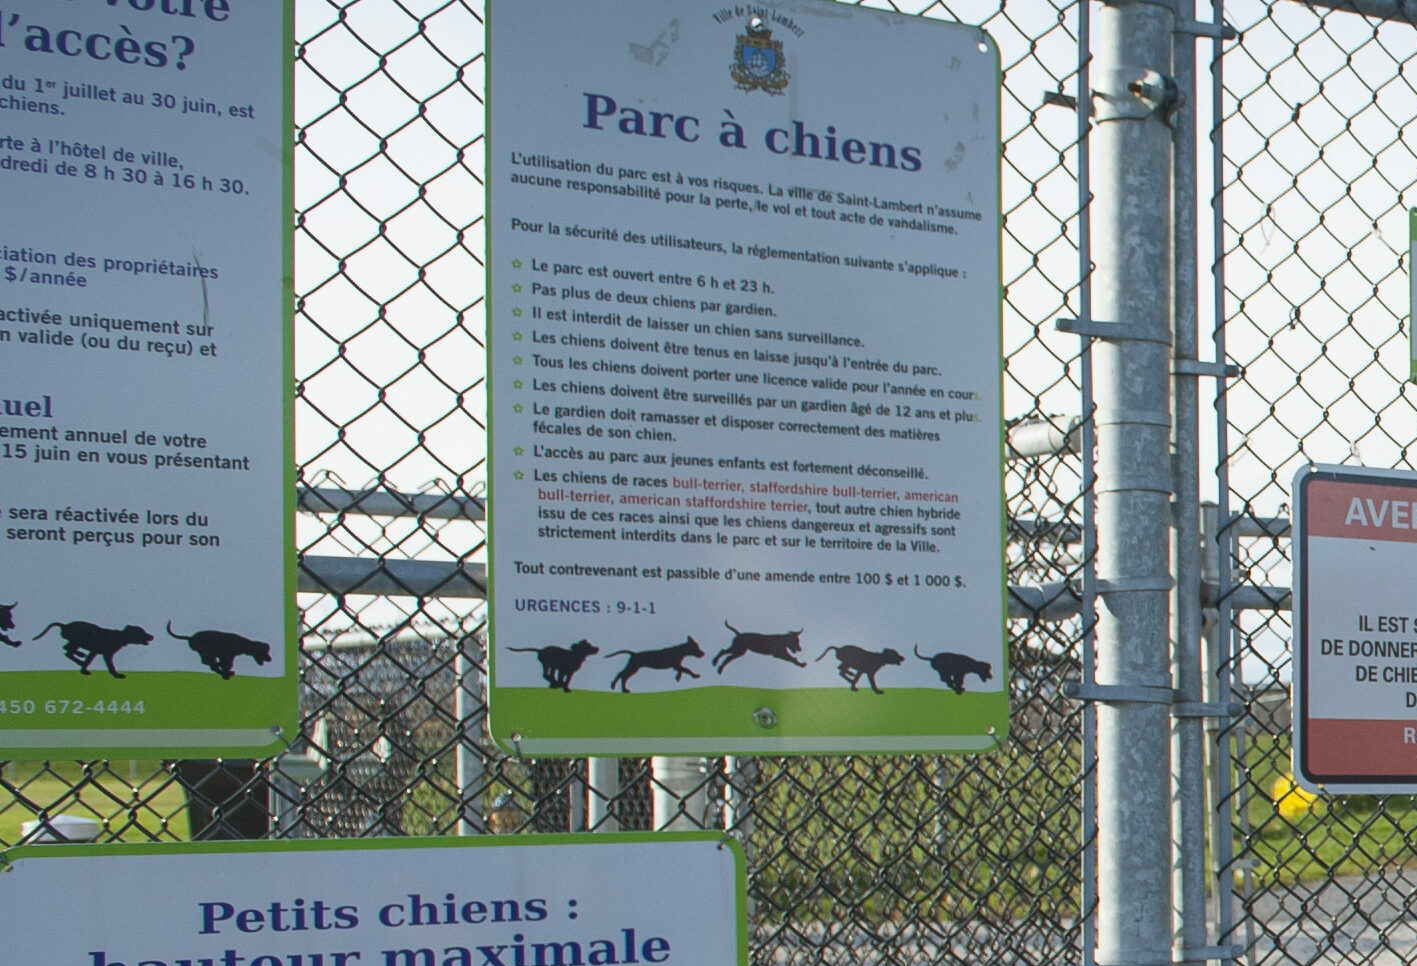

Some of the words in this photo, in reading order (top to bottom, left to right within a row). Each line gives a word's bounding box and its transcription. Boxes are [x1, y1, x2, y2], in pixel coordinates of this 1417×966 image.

[1, 74, 26, 91] du
[34, 77, 56, 94] 1er
[62, 81, 117, 103] juillet
[122, 92, 144, 106] au
[151, 92, 176, 109] 30
[182, 95, 222, 117] juin,
[228, 104, 255, 119] est
[583, 92, 700, 143] Parc
[719, 108, 747, 149] à
[764, 119, 922, 172] chiens
[511, 151, 592, 174] L'utilisation
[595, 162, 614, 177] du
[618, 167, 647, 181] parc
[651, 171, 672, 184] est
[675, 172, 684, 185] à
[687, 176, 709, 188] vos
[713, 176, 764, 195] risques.
[768, 183, 784, 197] La
[787, 186, 814, 201] ville
[817, 189, 833, 204] de
[836, 192, 923, 212] Saint-Lambert
[926, 204, 982, 222] n'assume
[532, 258, 549, 273] Le
[553, 263, 583, 276] parc
[587, 265, 608, 279] est
[612, 269, 654, 283] ouvert
[658, 273, 692, 287] entre
[696, 274, 706, 288] 6
[710, 276, 719, 289] h
[722, 278, 736, 291] et
[740, 279, 758, 293] 23
[762, 281, 775, 295] h.
[532, 420, 582, 436] fécales
[586, 424, 603, 438] de
[607, 428, 631, 439] son
[635, 427, 677, 442] chien.
[2, 442, 27, 459] 15
[33, 444, 70, 464] juin
[77, 450, 100, 463] en
[106, 451, 148, 466] vous
[154, 452, 250, 471] présentant
[6, 526, 66, 542] seront
[73, 530, 135, 547] perçus
[142, 532, 183, 548] pour
[189, 534, 220, 547] son
[515, 598, 601, 614] URGENCES
[616, 600, 656, 615] 9-1-1
[1359, 614, 1374, 632] IL
[1378, 615, 1410, 634] EST
[1321, 638, 1344, 656] DE
[1355, 665, 1378, 683] DE
[0, 699, 36, 714] 450
[44, 699, 146, 714] 672-4444
[198, 898, 359, 935] Petits
[378, 892, 548, 928] chiens
